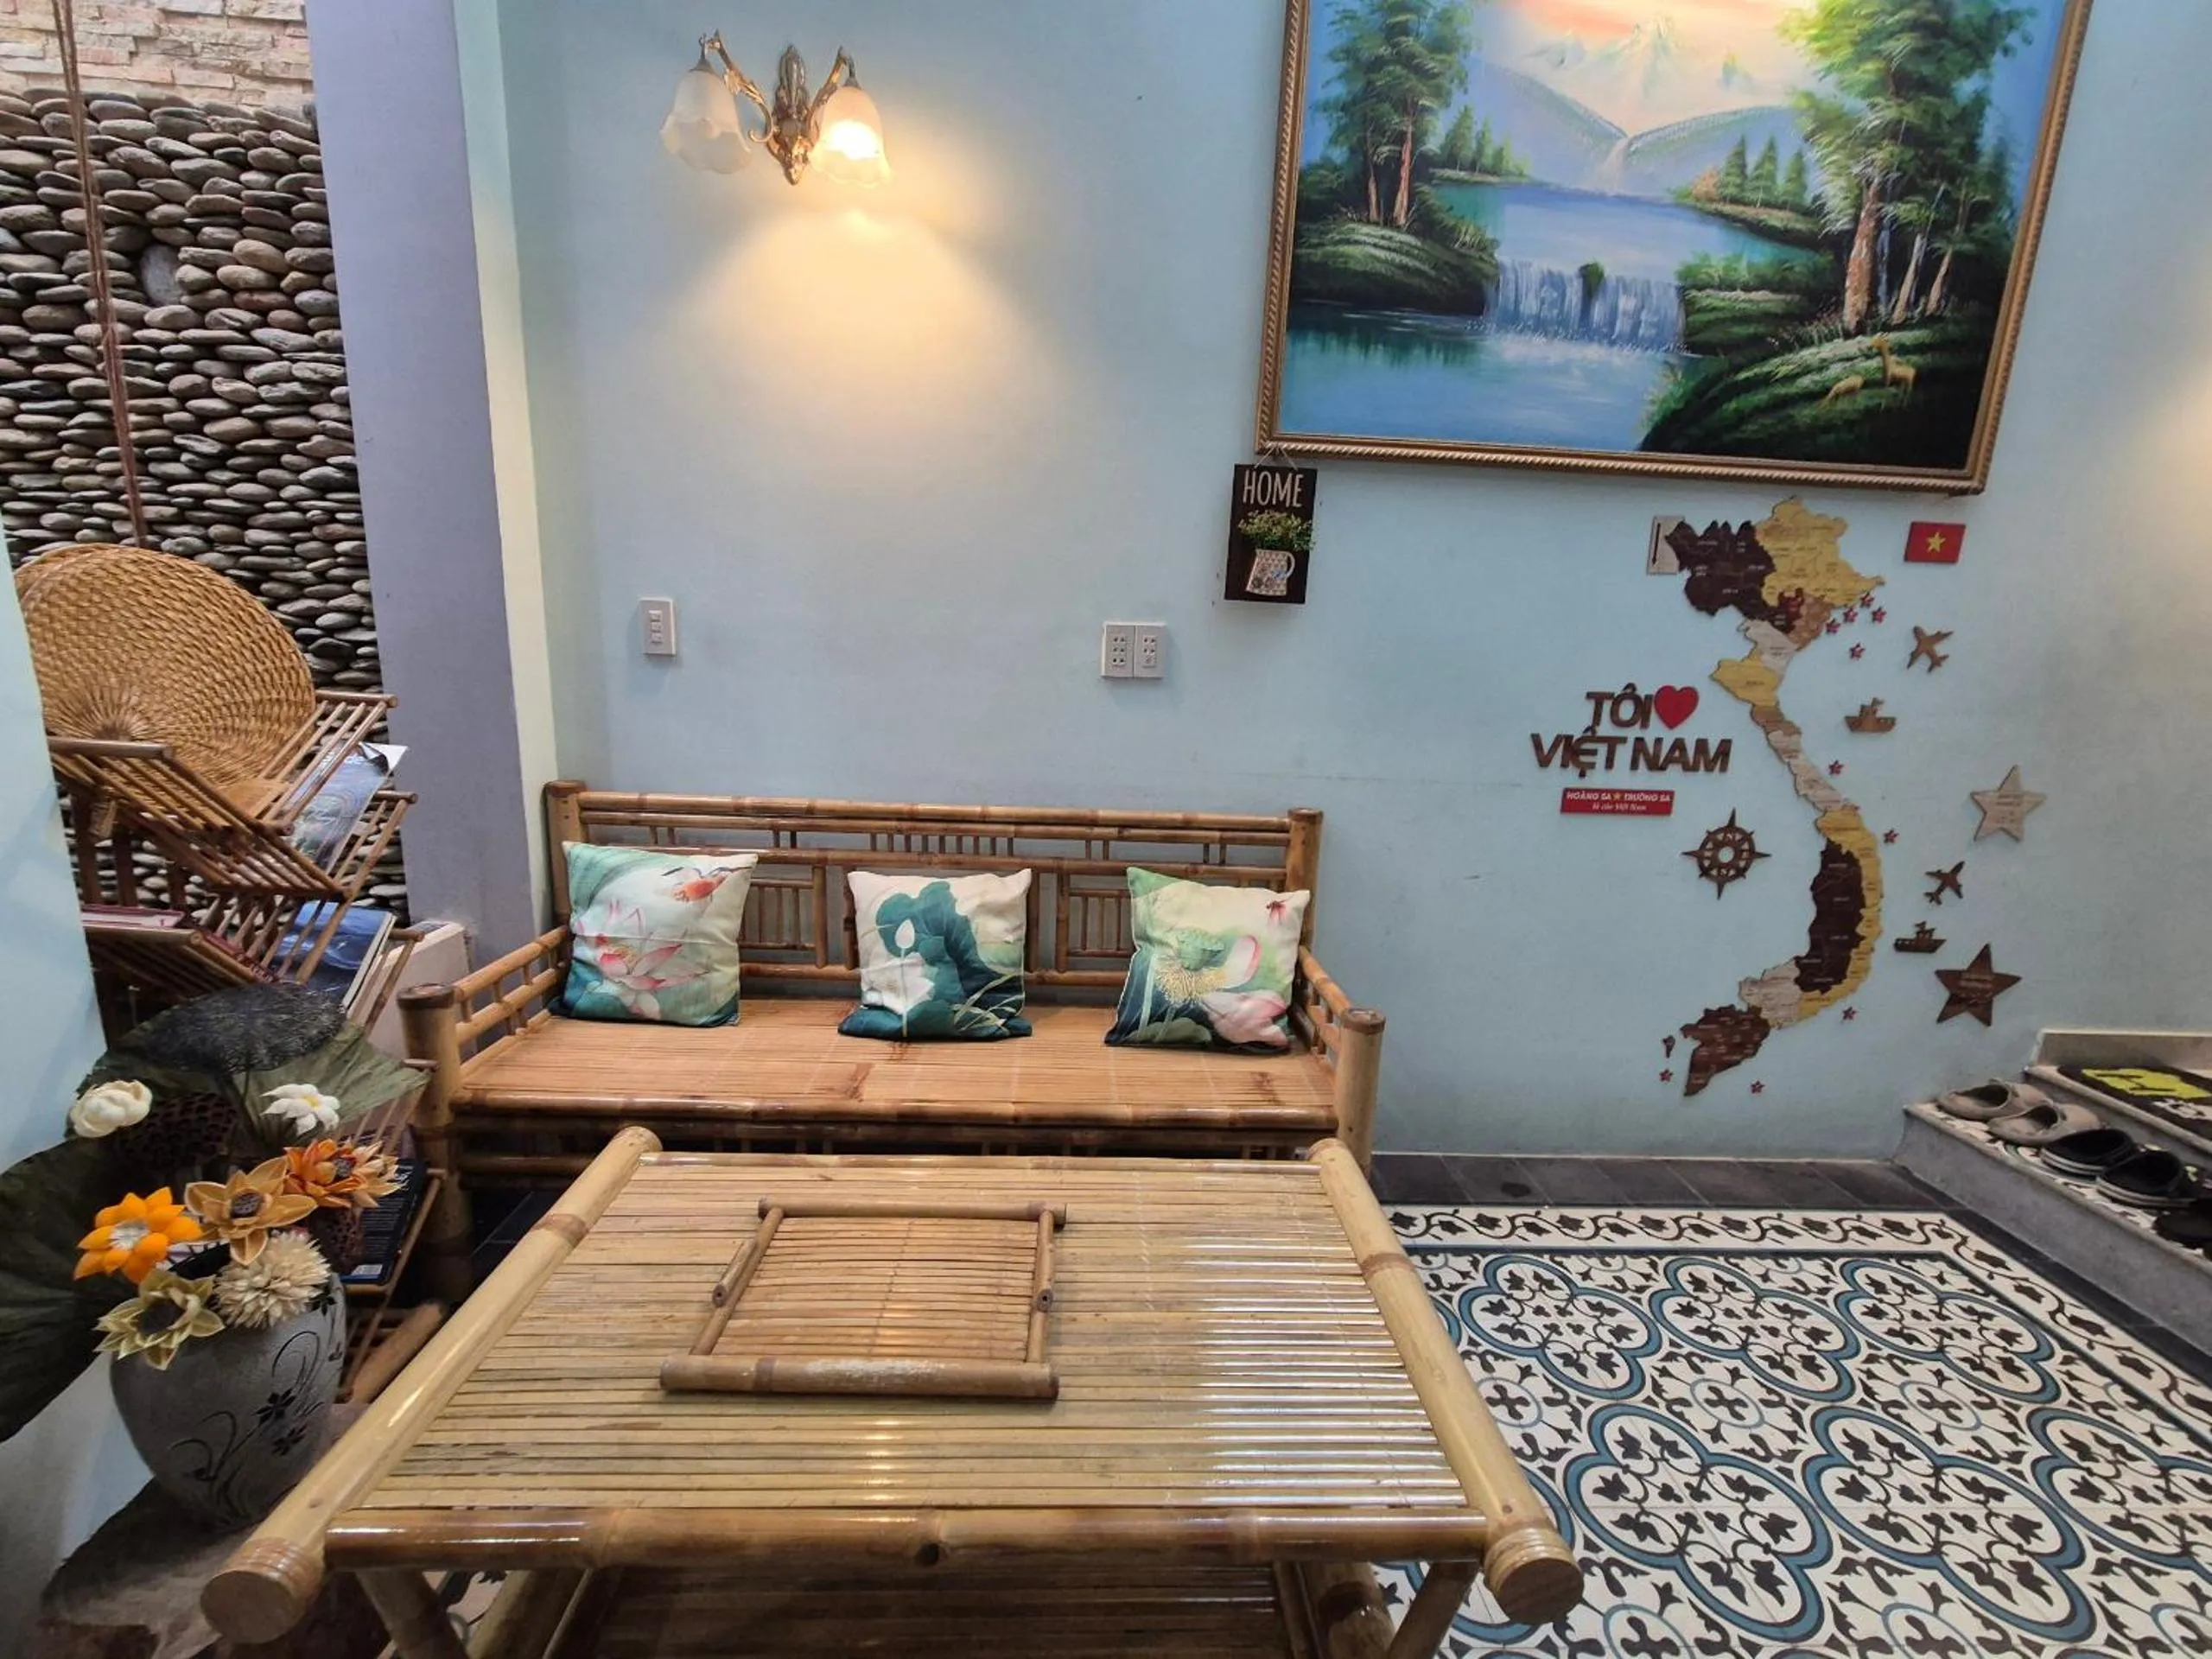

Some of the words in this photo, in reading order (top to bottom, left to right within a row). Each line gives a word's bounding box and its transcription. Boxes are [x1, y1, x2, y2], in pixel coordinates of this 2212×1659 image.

[1243, 469, 1304, 507] HOME
[1586, 682, 1654, 730] TÔI
[1530, 725, 1628, 779] VIỆT
[1630, 737, 1733, 772] NAM
